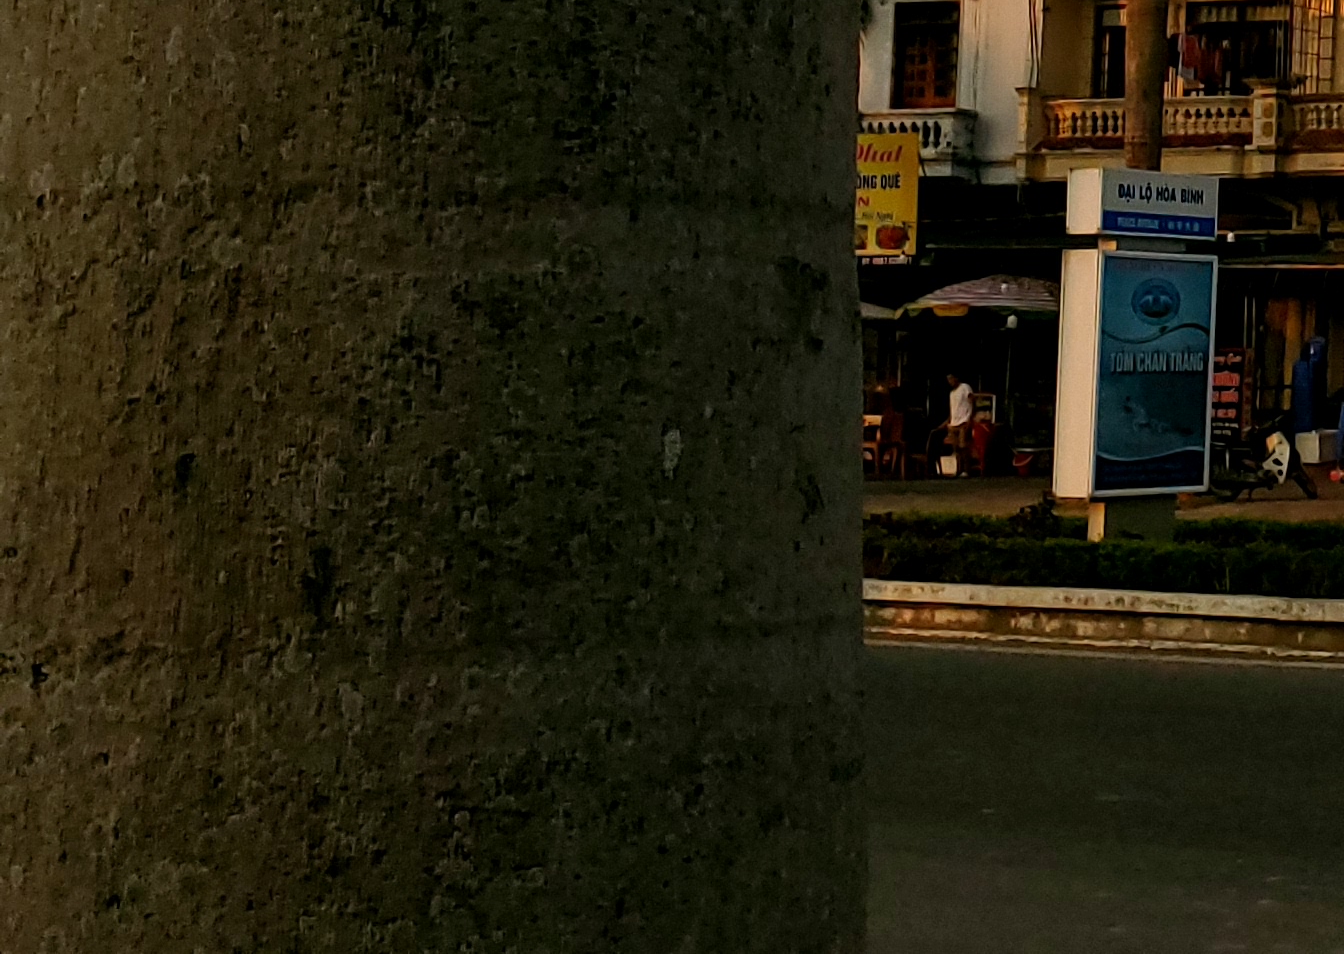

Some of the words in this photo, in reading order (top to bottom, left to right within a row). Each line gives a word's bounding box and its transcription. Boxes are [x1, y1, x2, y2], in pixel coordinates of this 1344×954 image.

[1118, 184, 1135, 203] ĐẠI
[1139, 183, 1152, 203] LỘ
[1156, 184, 1176, 202] HÒA
[1180, 186, 1203, 204] BÌNH
